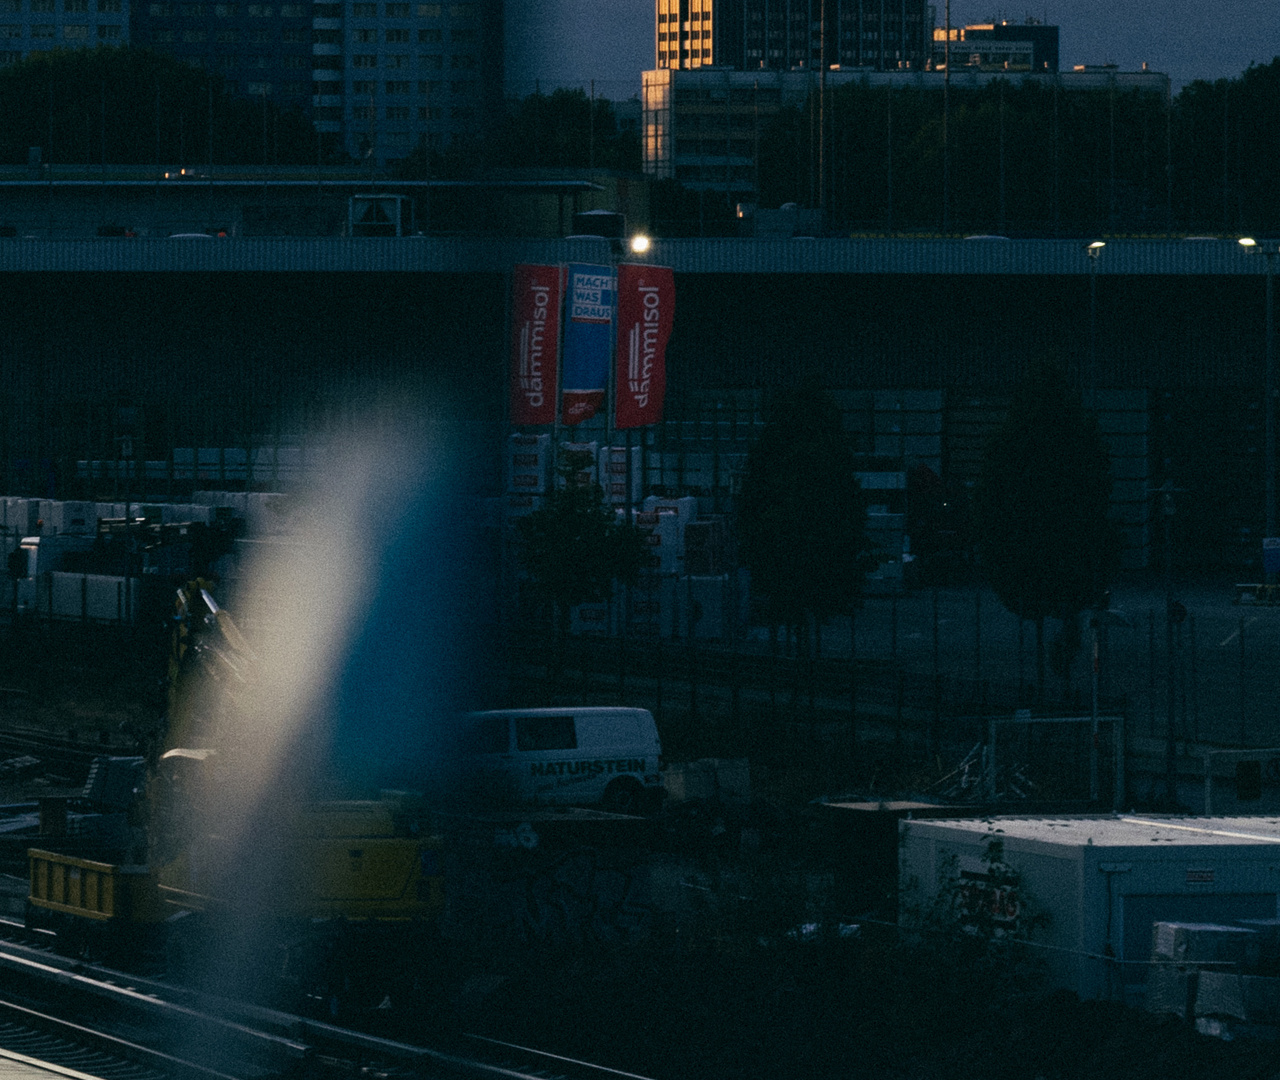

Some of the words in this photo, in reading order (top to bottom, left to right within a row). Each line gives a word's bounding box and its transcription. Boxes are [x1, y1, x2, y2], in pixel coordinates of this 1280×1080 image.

[575, 276, 609, 289] MACH
[575, 291, 599, 302] WAS
[531, 759, 646, 777] NATURSTEIN
